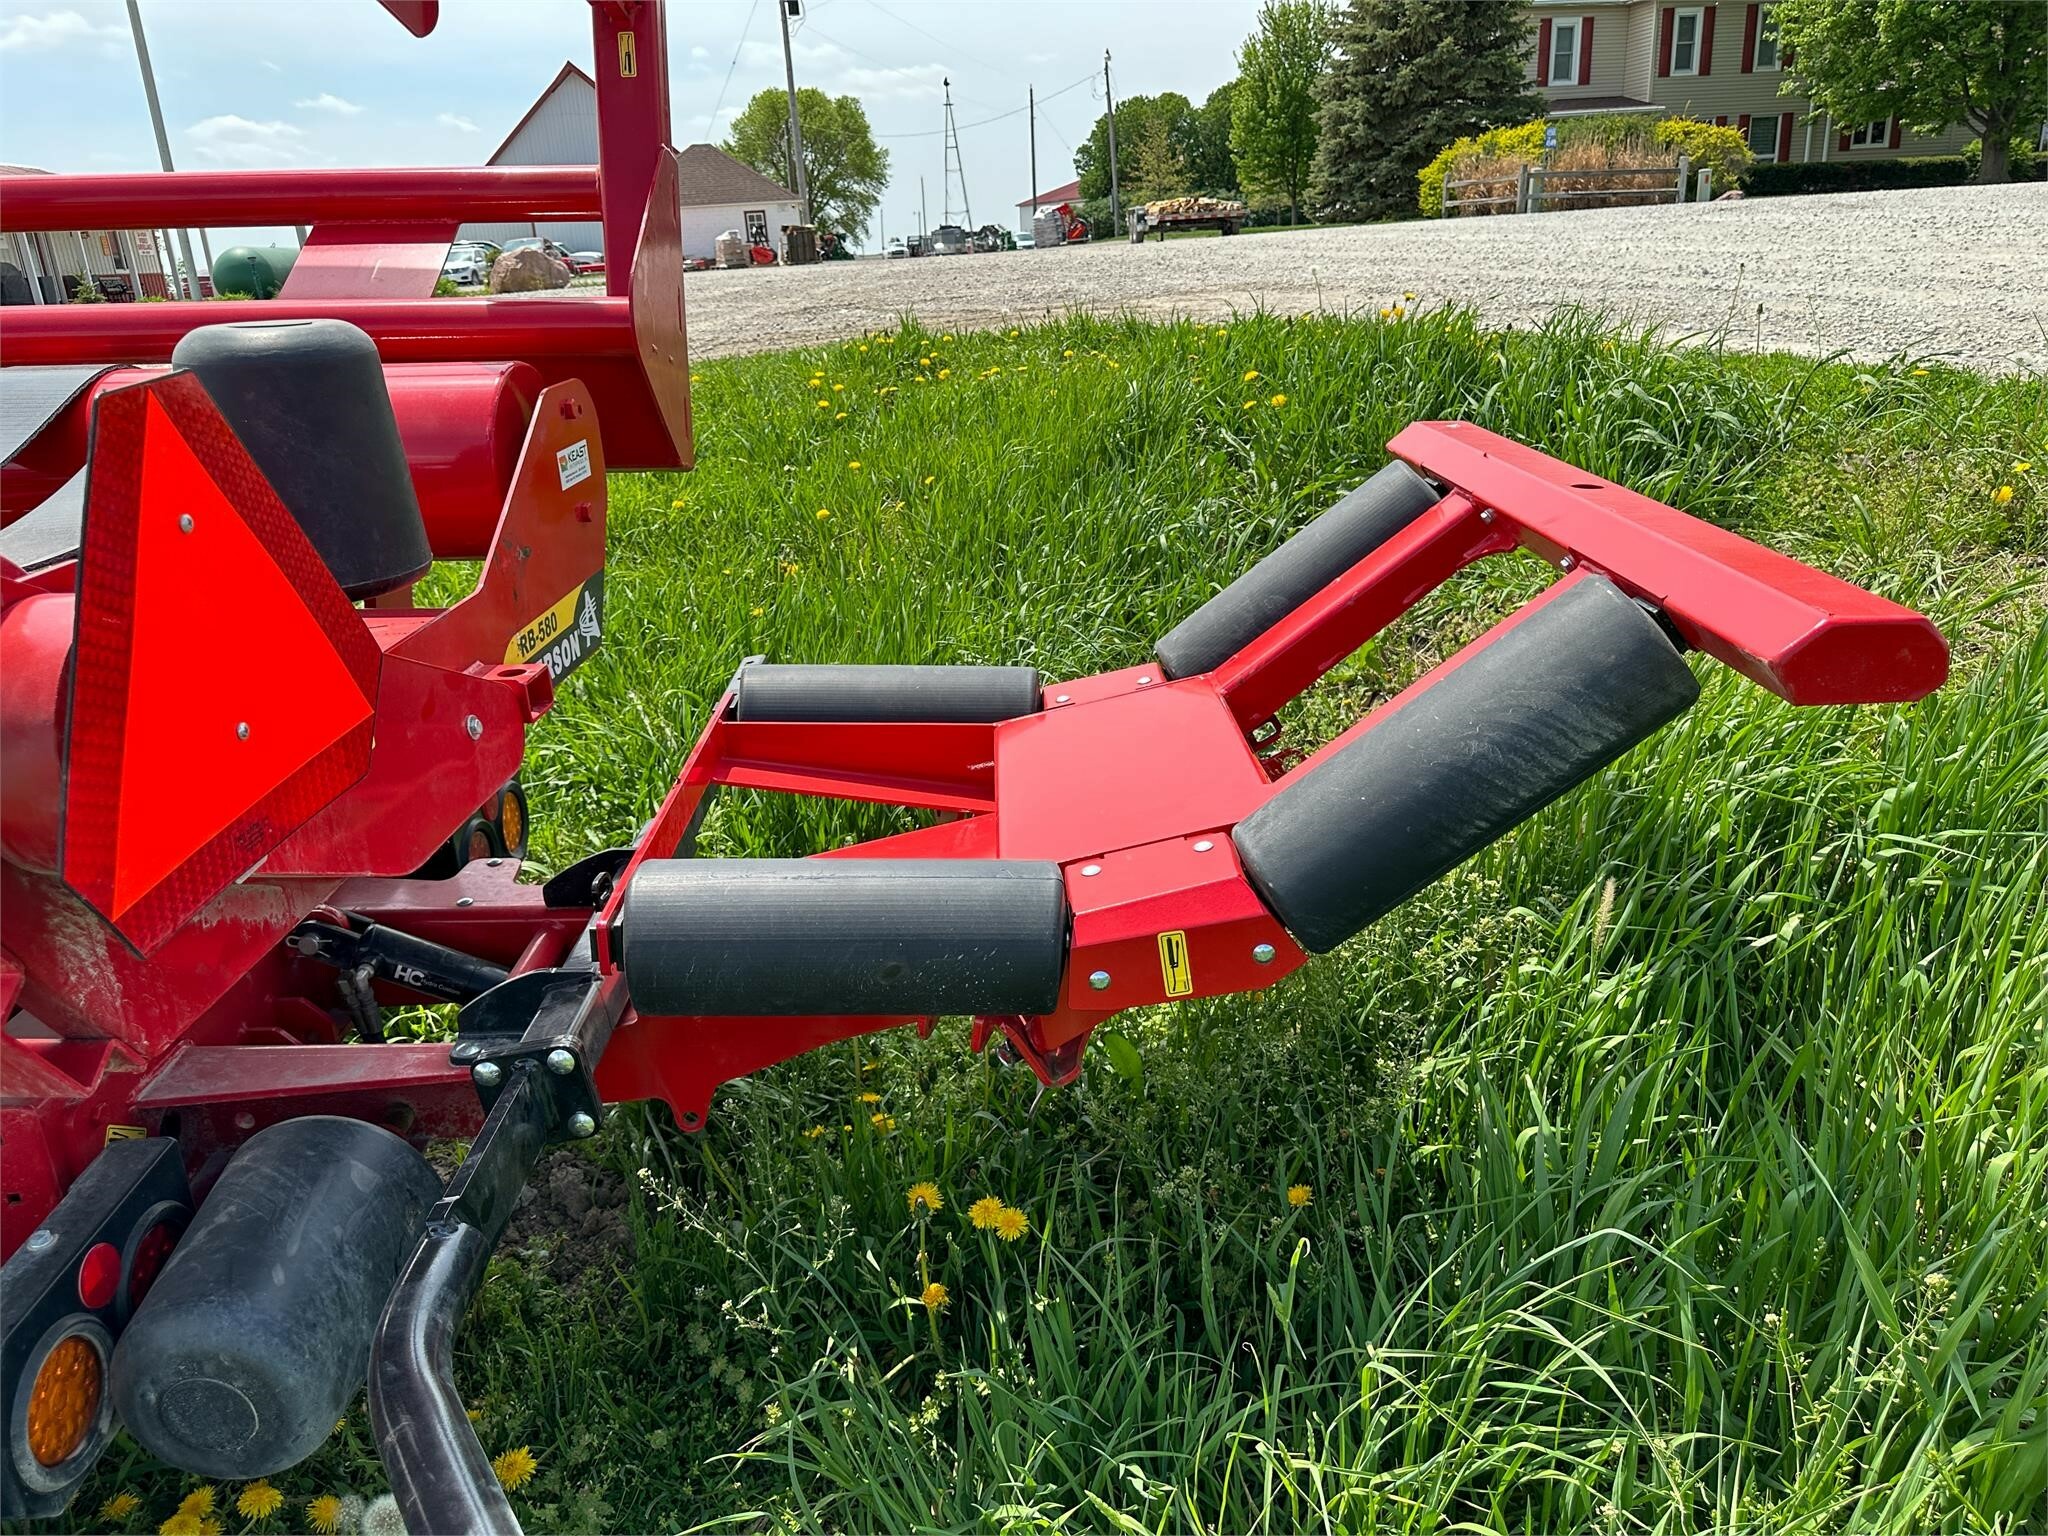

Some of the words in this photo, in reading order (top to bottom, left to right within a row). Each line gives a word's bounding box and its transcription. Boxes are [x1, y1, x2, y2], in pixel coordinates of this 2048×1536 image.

[567, 445, 586, 462] KEAST
[519, 612, 558, 658] RB-580
[538, 630, 581, 680] RSON
[394, 964, 425, 987] HC
